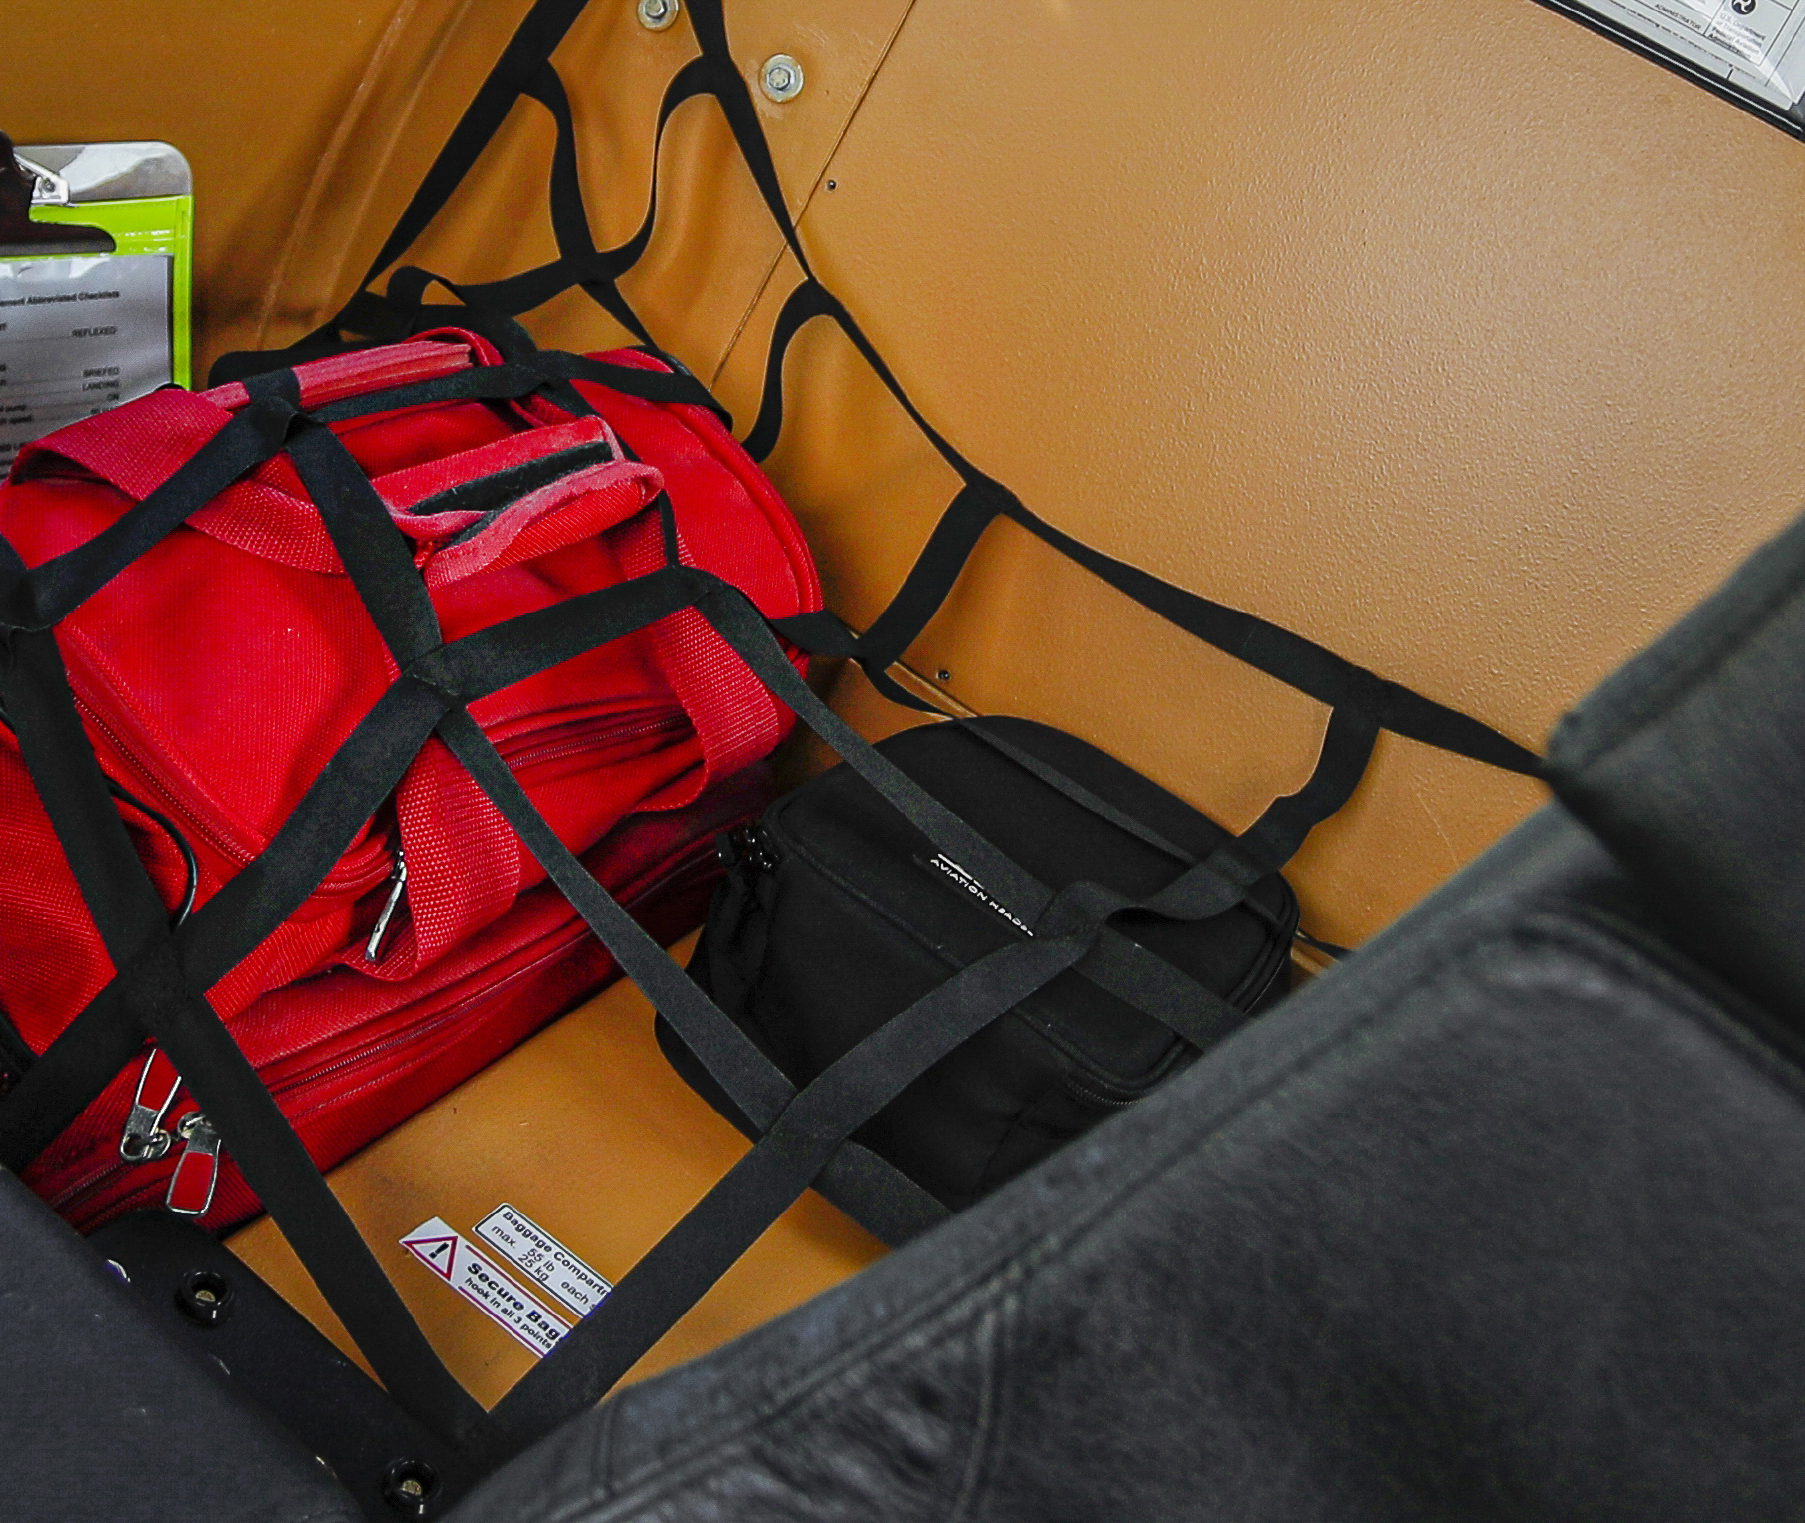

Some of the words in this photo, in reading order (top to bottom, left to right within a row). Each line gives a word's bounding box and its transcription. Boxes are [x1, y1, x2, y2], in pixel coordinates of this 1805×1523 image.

[929, 854, 988, 903] AVIATION
[500, 1209, 554, 1255] Baggage
[490, 1224, 518, 1248] max.
[559, 1277, 591, 1305] each
[517, 1251, 536, 1269] 25
[532, 1265, 550, 1283] kg
[526, 1245, 545, 1264] 55
[542, 1258, 556, 1273] lb
[463, 1275, 491, 1300] hook
[489, 1296, 502, 1309] in
[500, 1304, 515, 1318] all
[512, 1314, 523, 1324] 3
[465, 1260, 528, 1313] Secure
